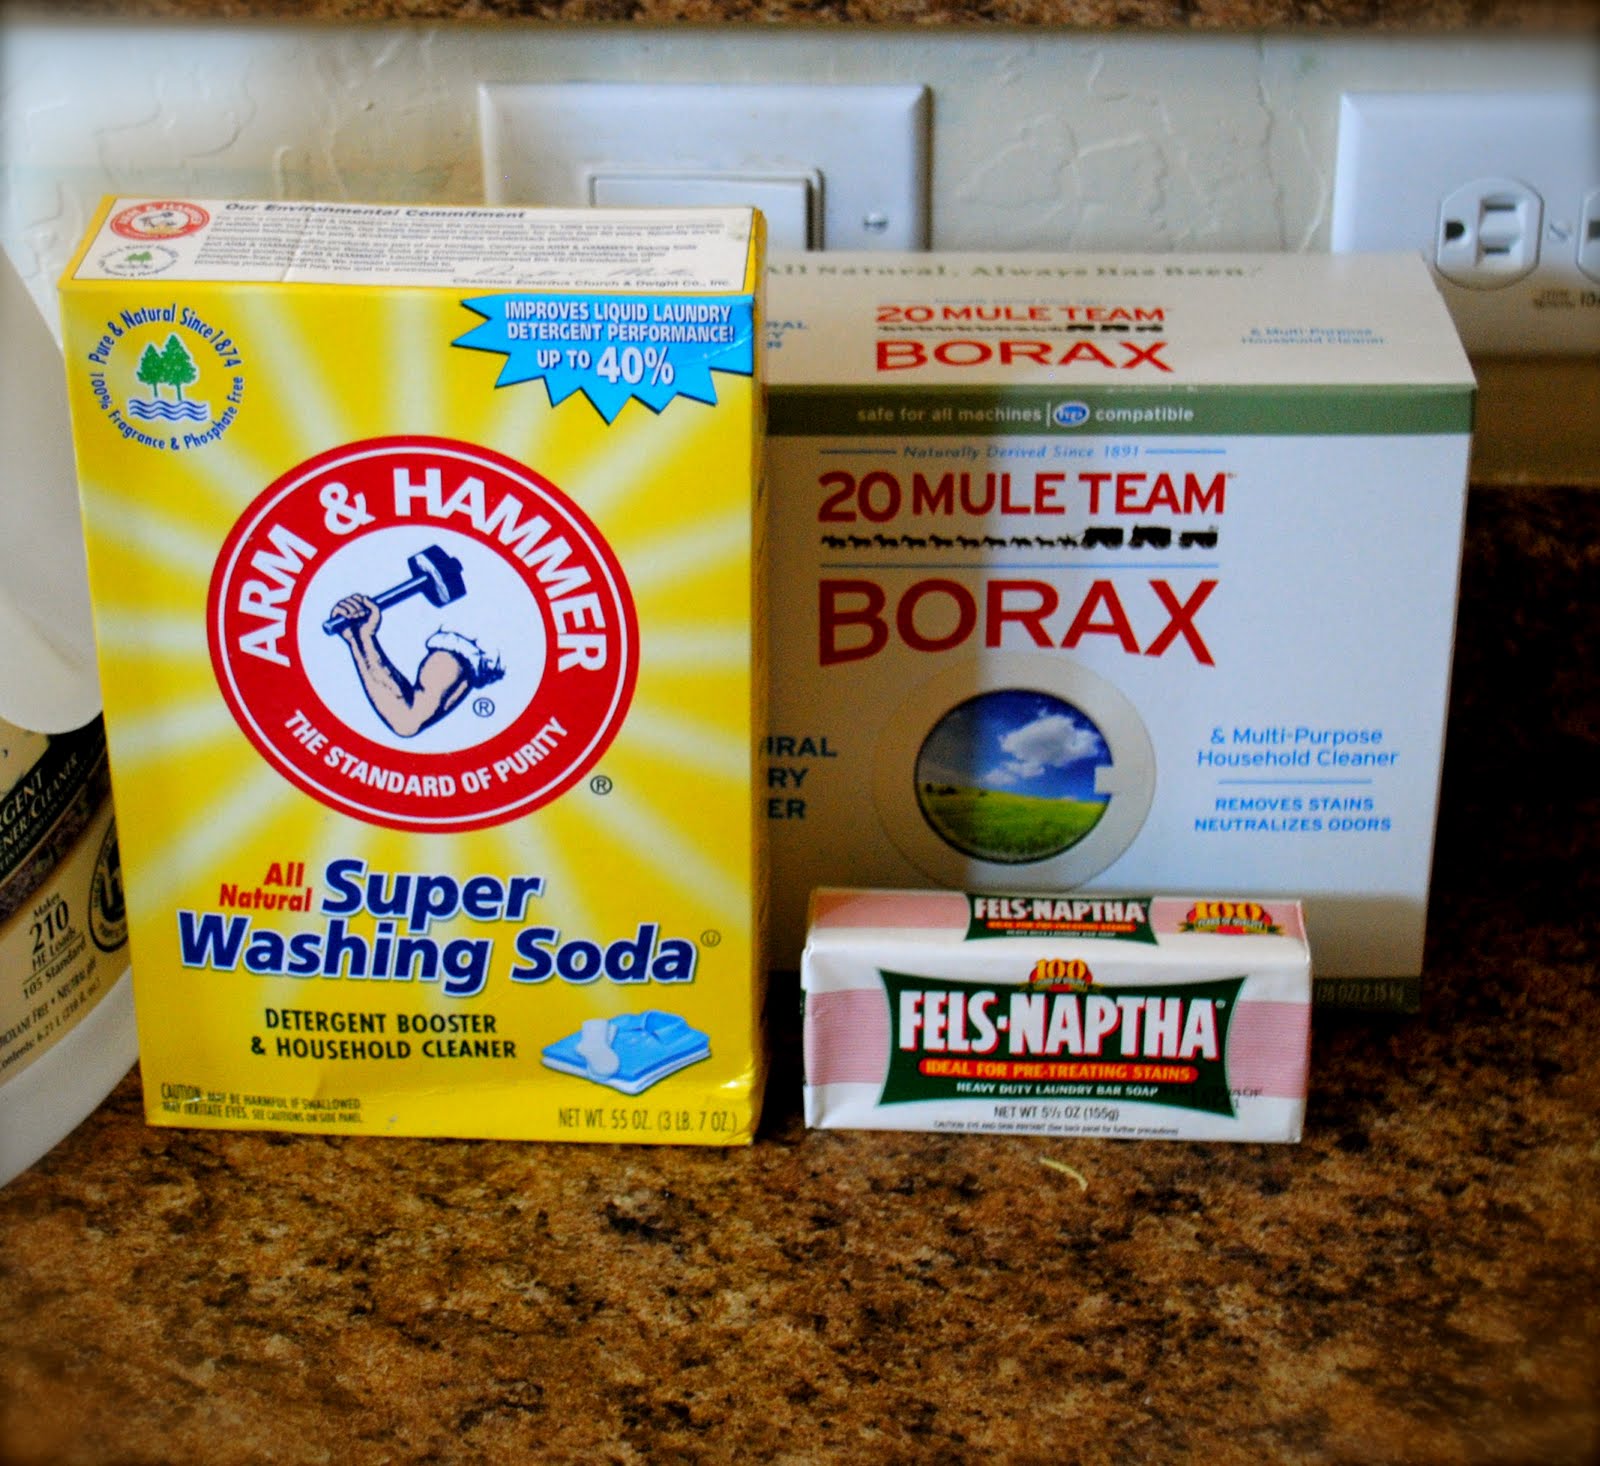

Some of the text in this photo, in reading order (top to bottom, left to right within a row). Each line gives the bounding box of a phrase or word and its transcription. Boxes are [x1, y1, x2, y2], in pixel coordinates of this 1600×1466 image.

[225, 203, 527, 219] Our Environmental Commitment
[505, 300, 732, 323] IMPROVES LIQUID LAUNDRY
[876, 305, 1165, 323] 20 MULE TEAM
[88, 303, 242, 368] Pure & Natural Since 1874
[507, 321, 735, 344] DETERGENT PERFORMANCE!
[536, 346, 675, 386] UP TO 40%
[876, 341, 1175, 373] BORAX
[90, 372, 244, 450] 100% Fragrance & Phosphate Free
[857, 407, 894, 422] safe
[900, 407, 925, 422] for
[932, 407, 952, 422] all
[958, 407, 1042, 422] machines
[1096, 407, 1195, 424] compatible
[903, 444, 1140, 461] Naturally Derived Since 1891
[818, 471, 1226, 523] 20 MULE TEAM
[239, 467, 607, 673] ARM & HAMMER
[818, 578, 1219, 667] BORAX
[1210, 727, 1383, 748] & Multi-Purpose
[284, 709, 568, 798] THE STANDARD OF PURITY
[1197, 750, 1400, 768] Household Cleaner
[1215, 797, 1375, 812] REMOVES STAINS
[1193, 818, 1393, 833] NEUTRALIZES ODORS
[263, 862, 305, 888] All
[219, 884, 313, 913] Natural
[321, 857, 544, 935] Super
[1194, 901, 1263, 920] 100
[29, 900, 69, 956] 210
[177, 910, 698, 997] Washing Soda
[22, 978, 42, 1001] 105
[45, 935, 87, 983] Standard
[1035, 959, 1086, 980] 100
[265, 1007, 497, 1034] DETERGENT BOOSTER
[251, 1036, 516, 1060] & HOUSEHOLD CLEANER
[925, 1059, 1191, 1081] IDEAL FOR PRE-TREATING STAINS
[956, 1081, 1159, 1097] HEAVY DUTY LAUNDRY BAR SOAP
[557, 1107, 581, 1129] NET
[611, 1110, 628, 1130] 55
[632, 1111, 653, 1131] OZ.
[699, 1112, 708, 1132] 7
[993, 1106, 1017, 1119] NET
[1019, 1106, 1038, 1119] WT
[1064, 1106, 1081, 1120] OZ
